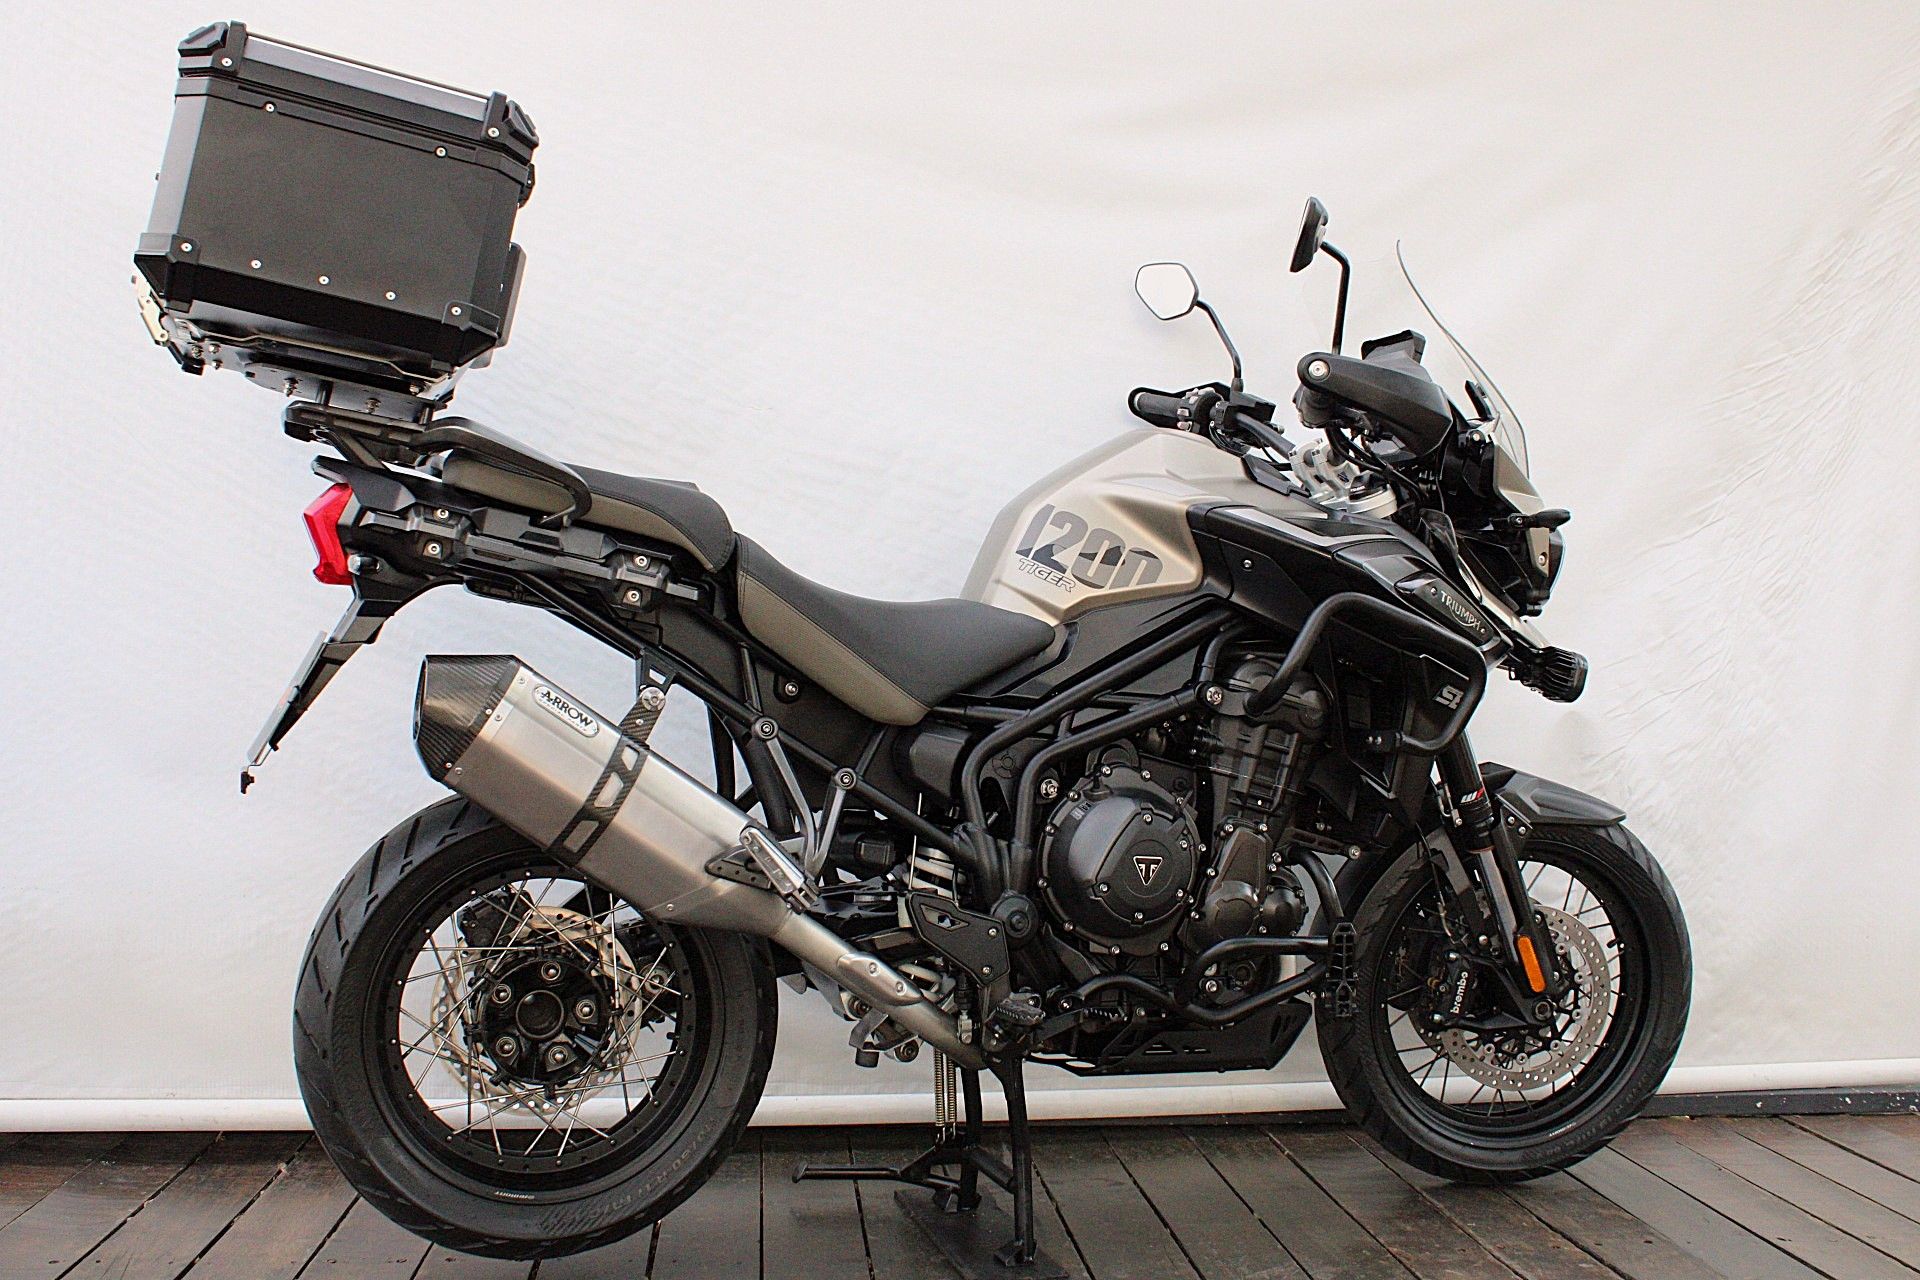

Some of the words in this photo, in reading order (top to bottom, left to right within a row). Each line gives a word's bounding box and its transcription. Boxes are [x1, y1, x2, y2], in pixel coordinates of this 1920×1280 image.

[1019, 558, 1076, 592] TIGER
[1441, 590, 1481, 631] TRIUMPH
[541, 690, 593, 727] ARROW
[1450, 971, 1468, 1013] brembo
